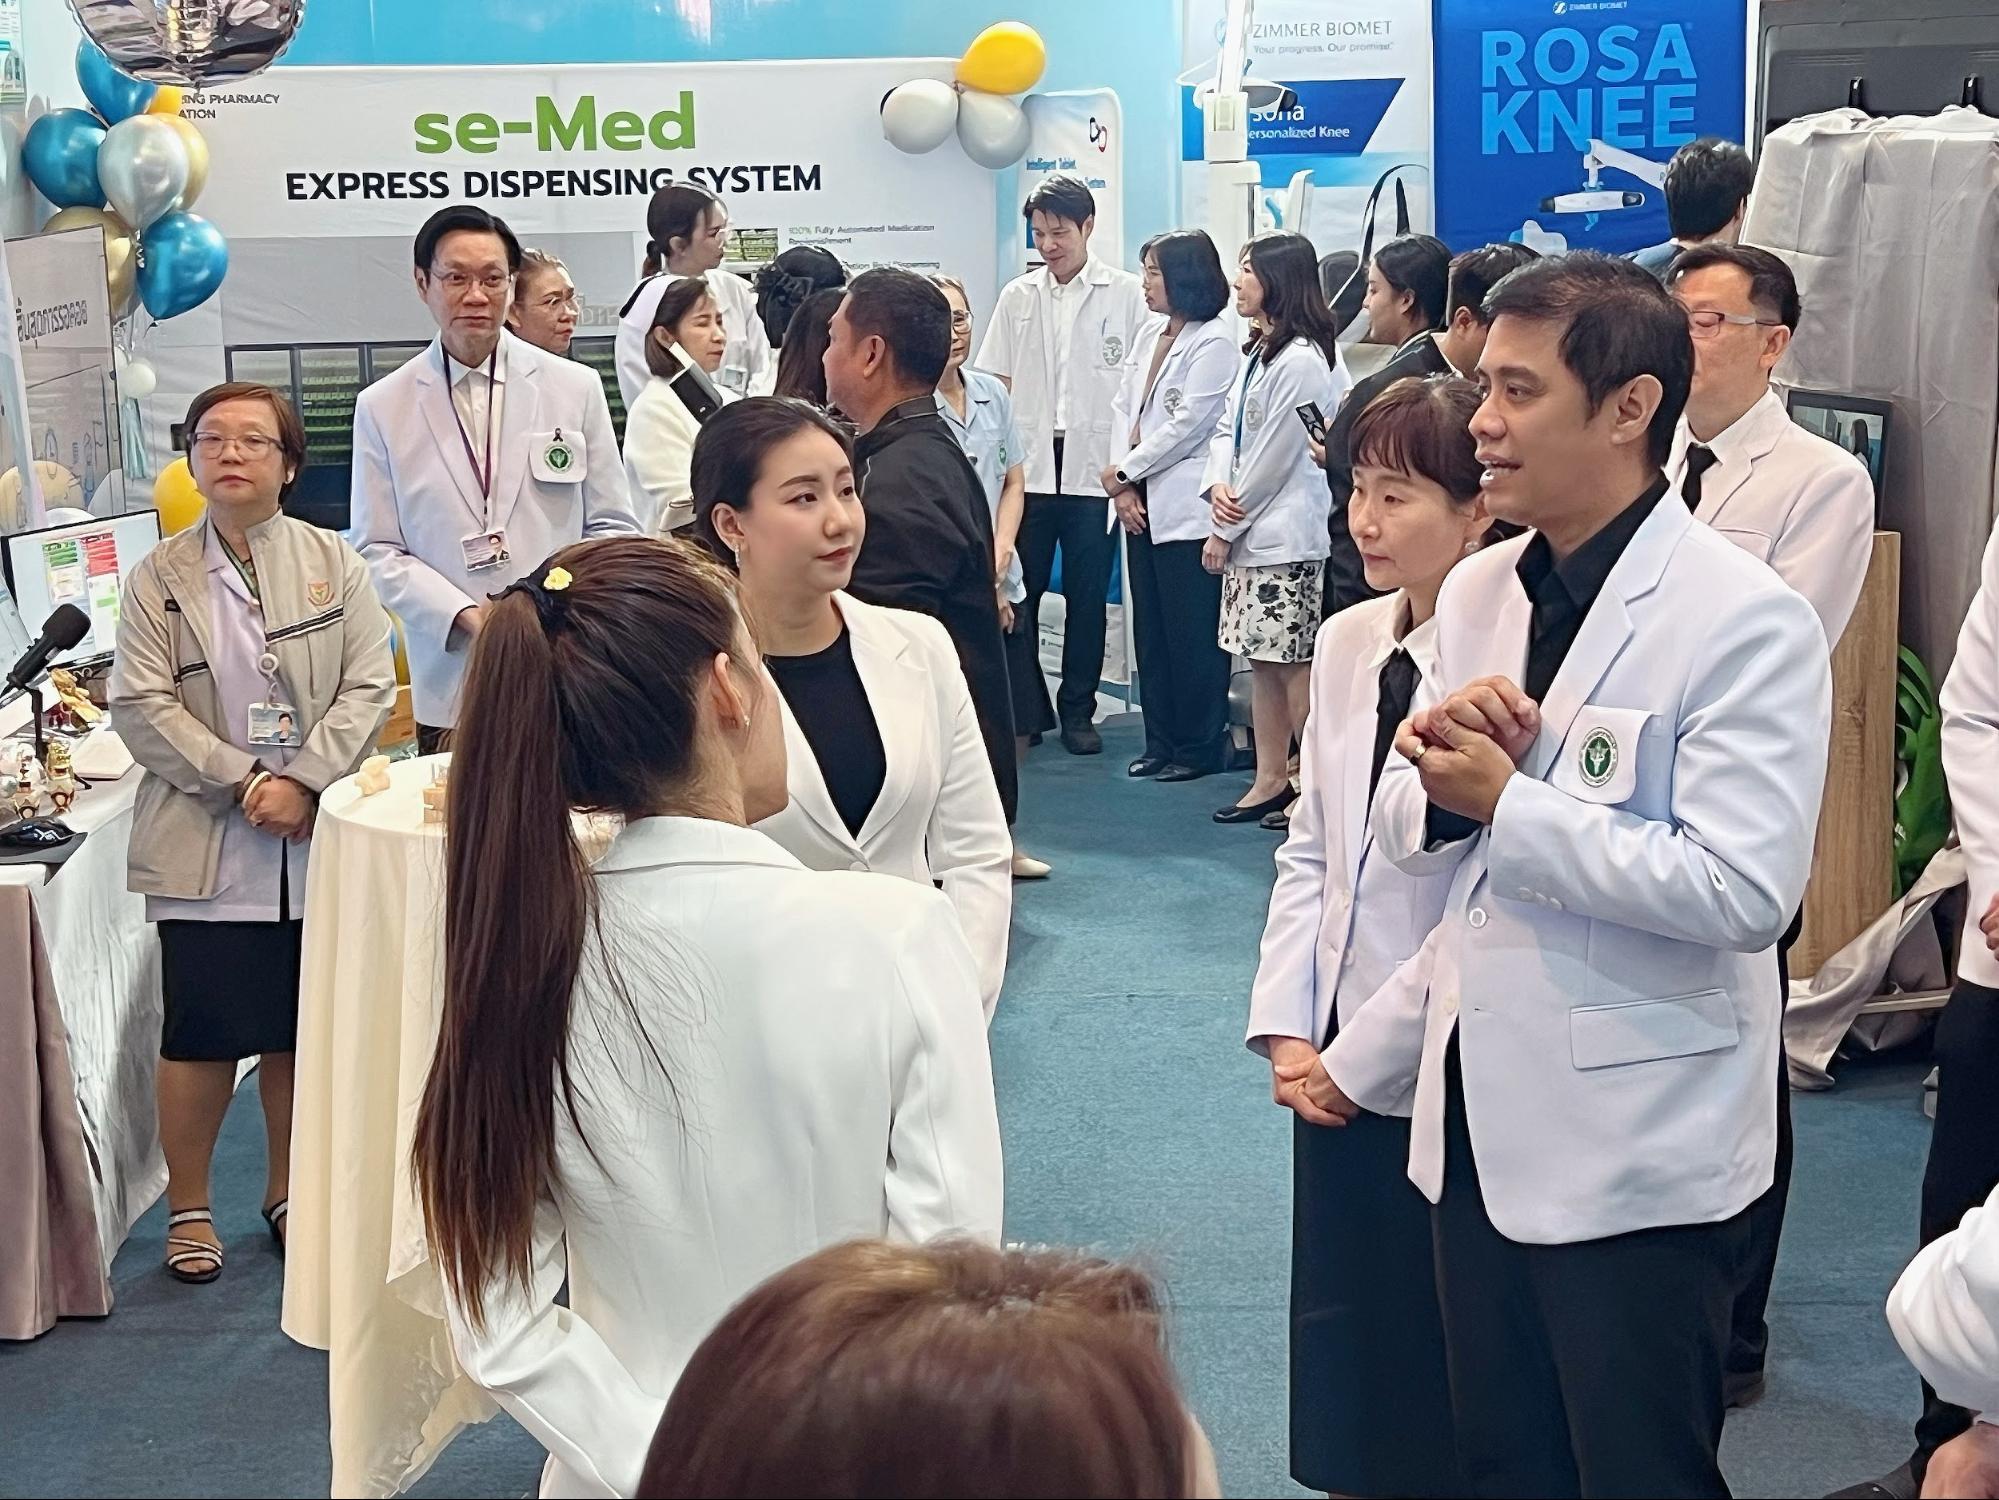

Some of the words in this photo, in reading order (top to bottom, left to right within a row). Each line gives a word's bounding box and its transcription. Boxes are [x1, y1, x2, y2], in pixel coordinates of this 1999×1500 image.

[1252, 22, 1320, 39] ZIMMER
[1326, 20, 1393, 36] BIOMET
[1253, 44, 1276, 54] Your
[1278, 44, 1325, 55] progress.
[1327, 42, 1347, 53] Our
[1481, 23, 1698, 88] ROSA
[209, 93, 280, 104] PHARMACY
[414, 90, 697, 154] se-Med
[1481, 83, 1697, 155] KNEE
[1248, 125, 1316, 139] ersonalized
[1319, 126, 1350, 138] Knee
[286, 171, 451, 200] EXPRESS
[464, 168, 674, 199] DISPENSING
[687, 164, 822, 194] SYSTEM
[815, 225, 834, 236] Fully
